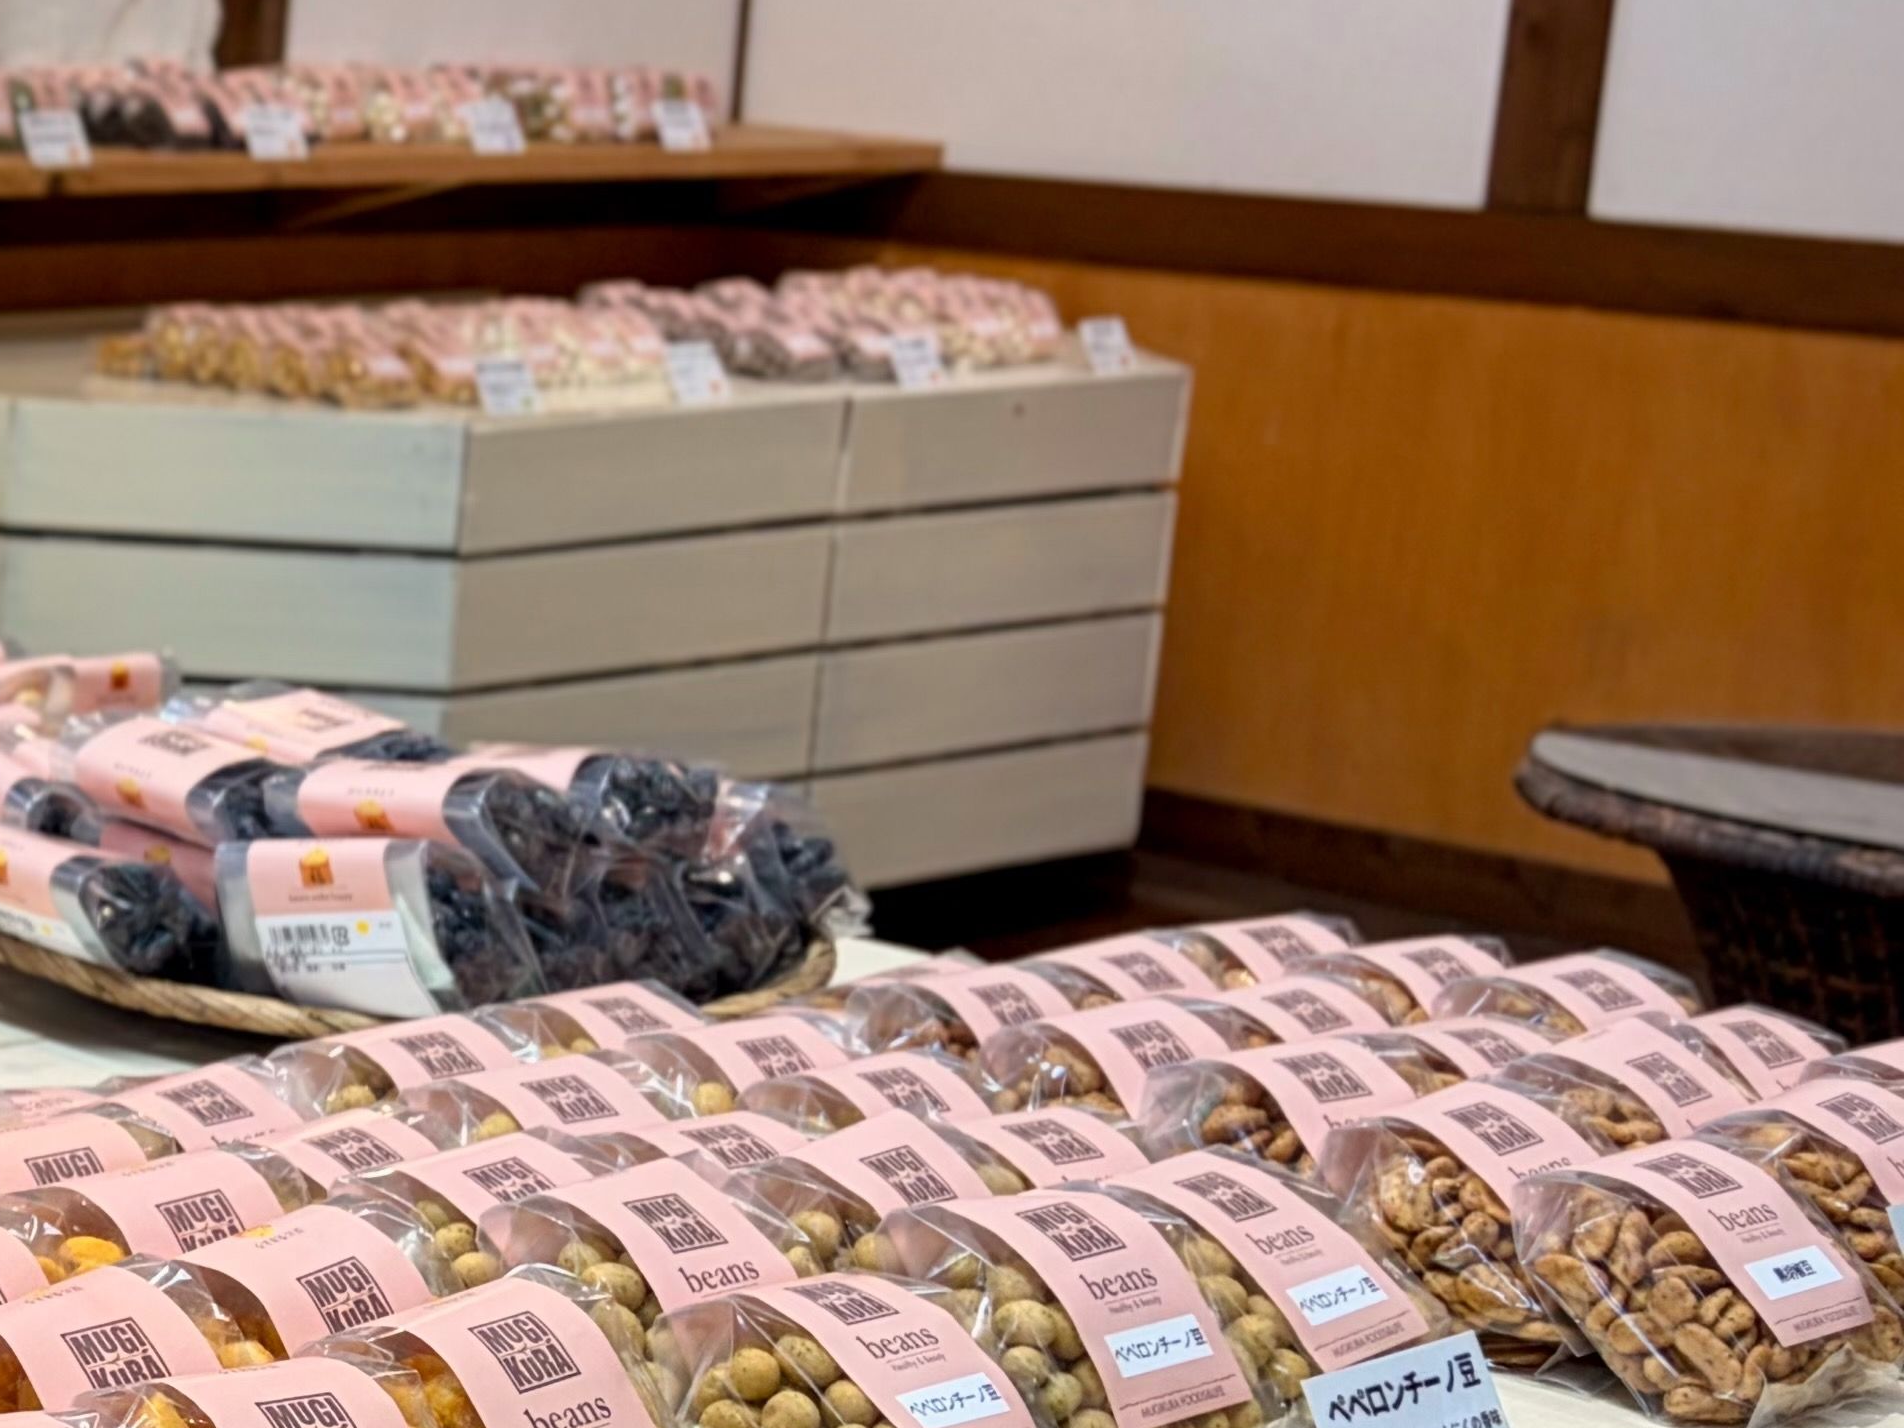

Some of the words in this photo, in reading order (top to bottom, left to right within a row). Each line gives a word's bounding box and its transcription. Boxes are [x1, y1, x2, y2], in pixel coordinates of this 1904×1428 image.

[161, 1193, 233, 1233] MUGI
[630, 1195, 692, 1225] MUGI
[1216, 1191, 1277, 1221] KURA
[1708, 1201, 1780, 1233] beans
[660, 1217, 724, 1252] KURA
[1052, 1222, 1125, 1259] KURA
[1245, 1221, 1316, 1258] beans
[679, 1257, 760, 1294] beans
[1080, 1263, 1158, 1302] beans
[855, 1324, 940, 1361] beans
[1328, 1352, 1481, 1422] ペペロンチーノ豆
